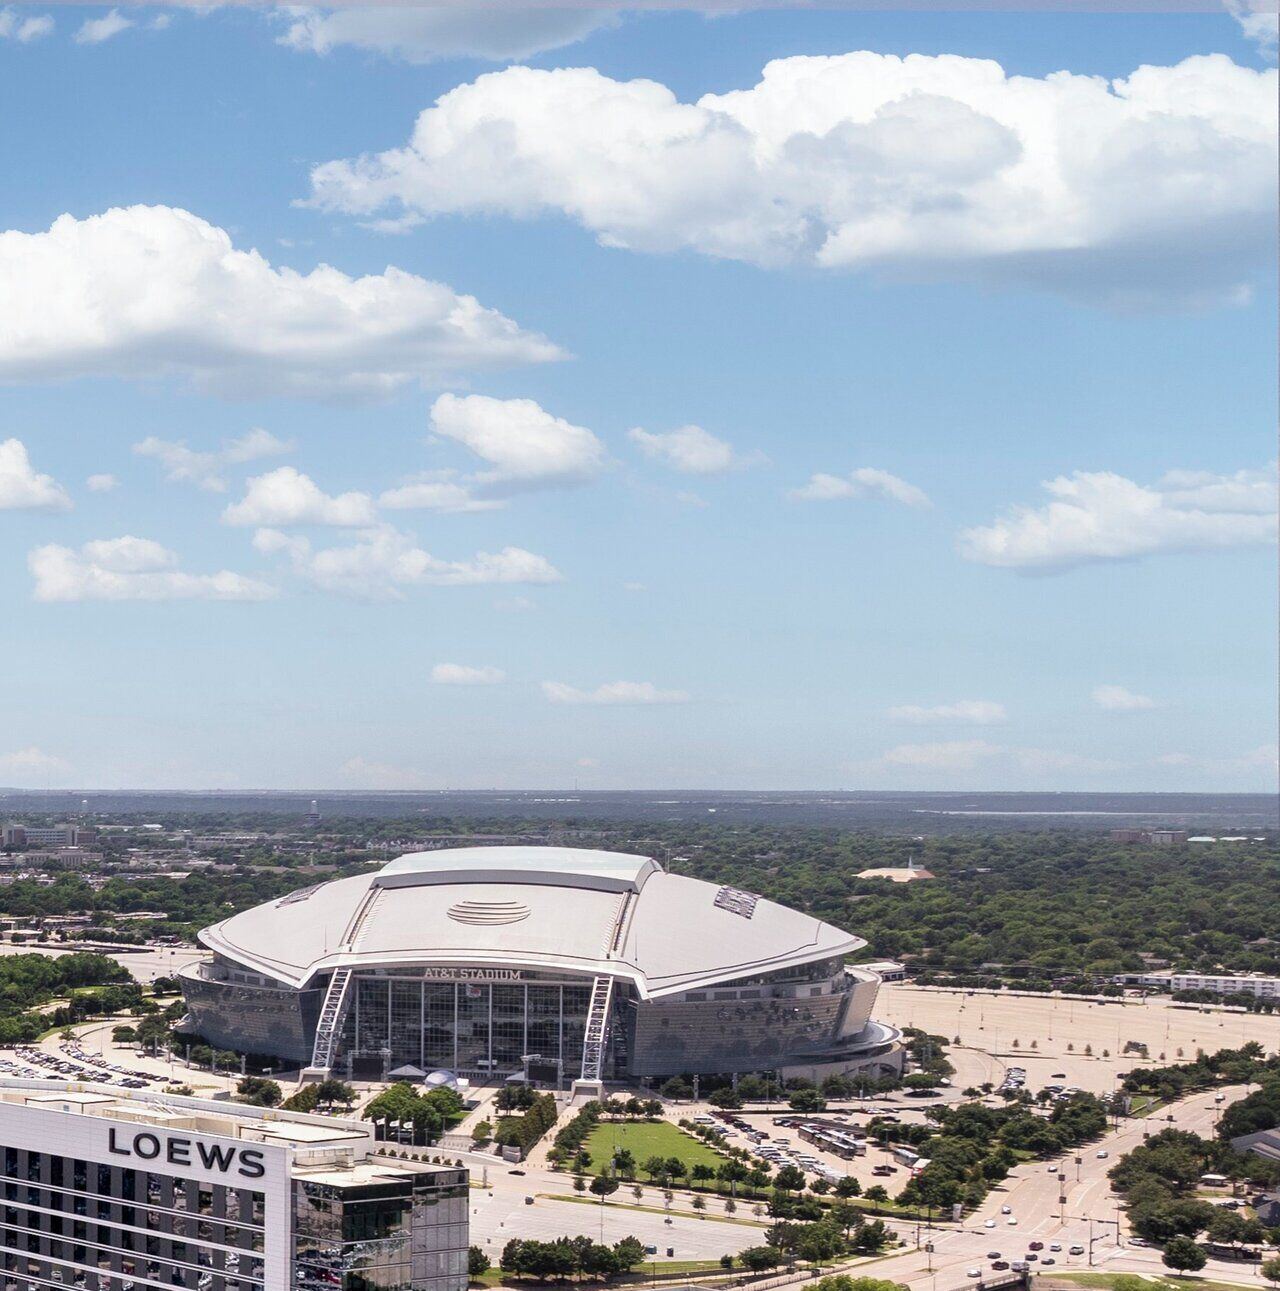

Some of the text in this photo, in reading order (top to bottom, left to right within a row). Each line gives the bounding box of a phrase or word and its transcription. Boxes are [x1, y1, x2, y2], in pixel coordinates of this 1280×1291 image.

[424, 968, 521, 980] AT&T STADIUM
[109, 1128, 265, 1178] LOEWS
